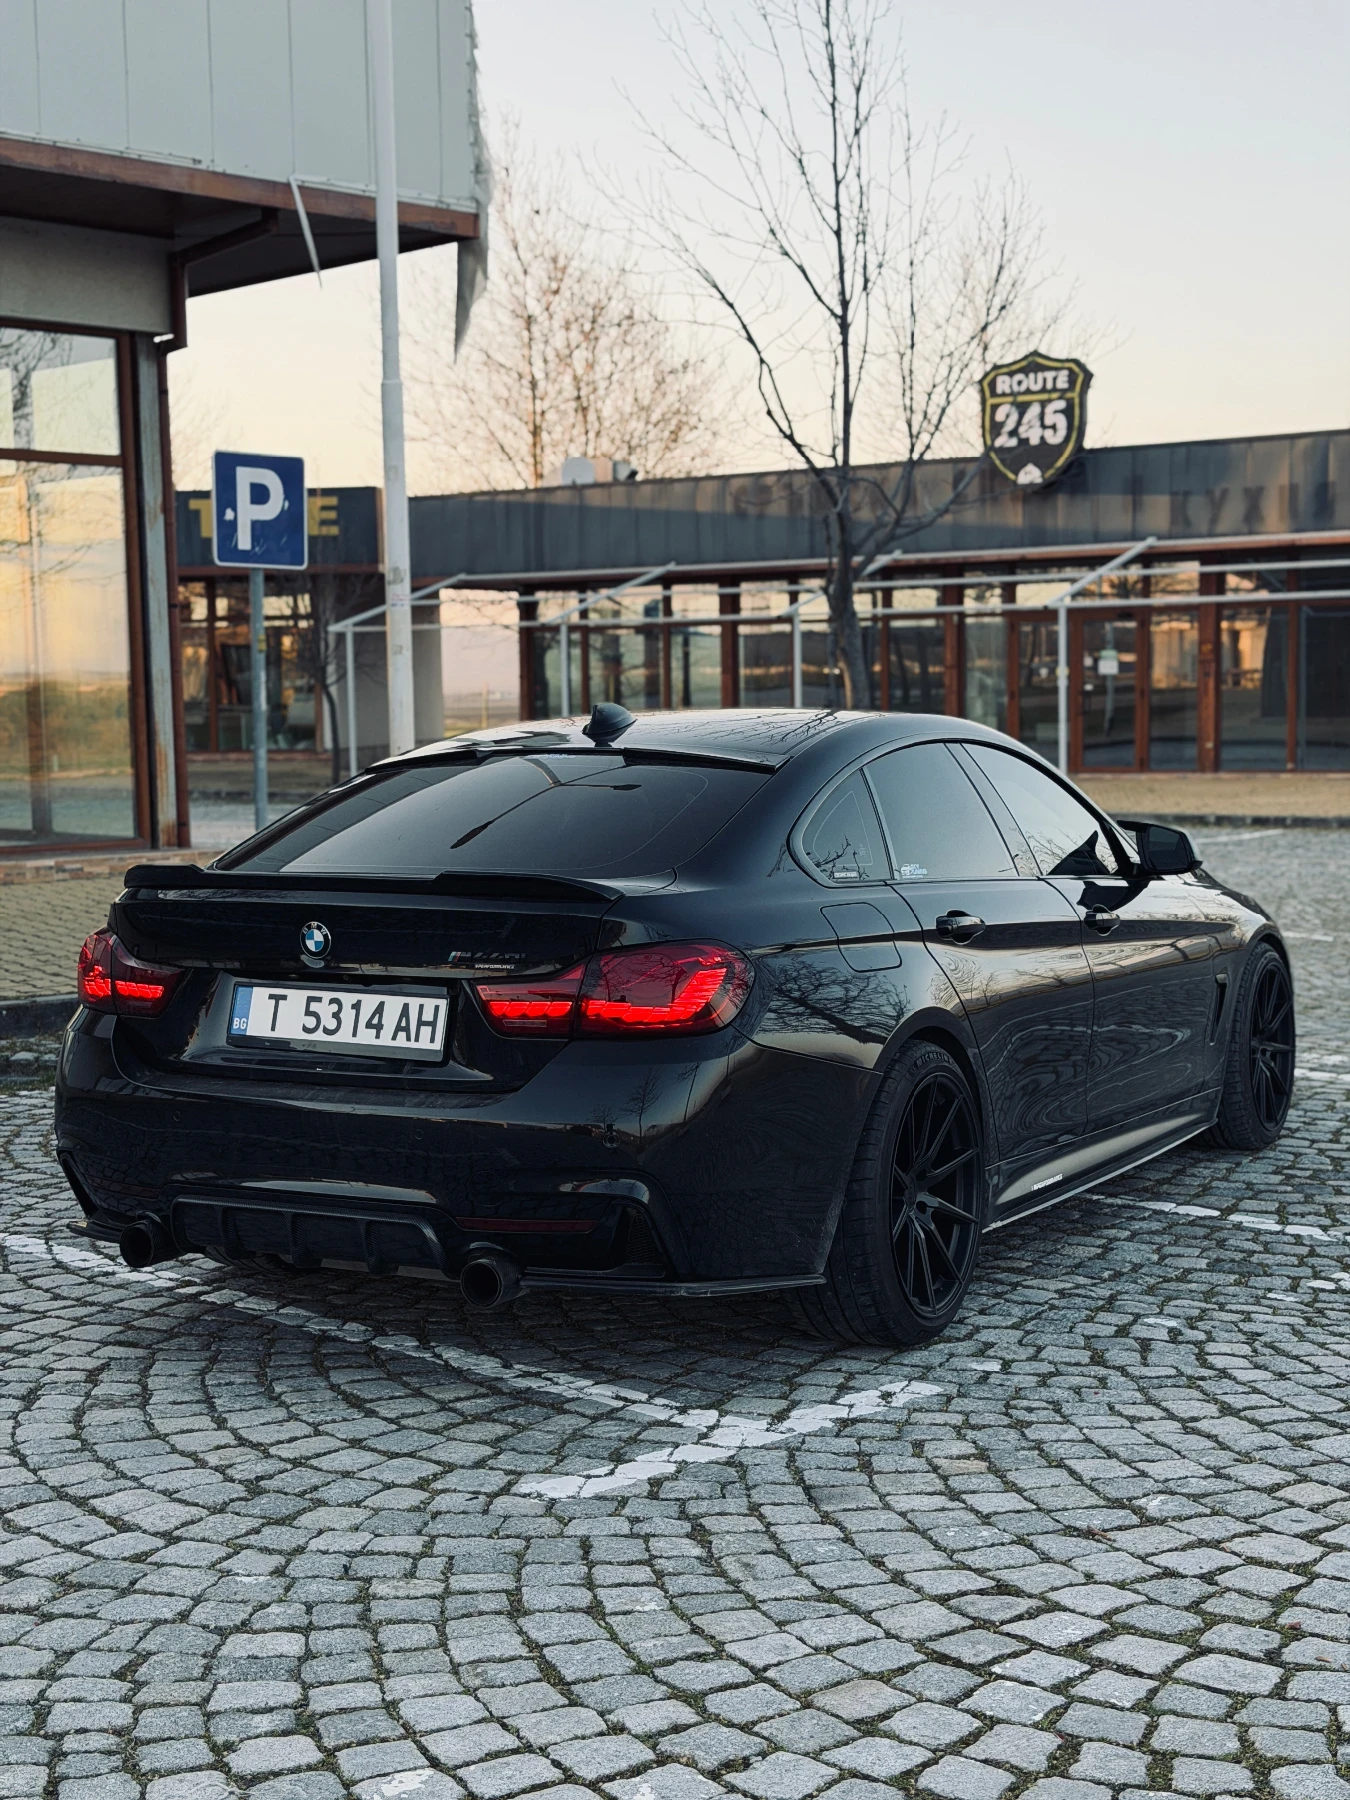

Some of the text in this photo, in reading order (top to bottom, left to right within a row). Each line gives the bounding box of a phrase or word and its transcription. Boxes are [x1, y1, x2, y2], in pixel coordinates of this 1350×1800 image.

[995, 369, 1070, 394] ROUTE
[993, 399, 1068, 448] 245
[236, 466, 285, 550] P
[232, 1017, 247, 1030] BG
[267, 993, 440, 1044] T 5314 AH
